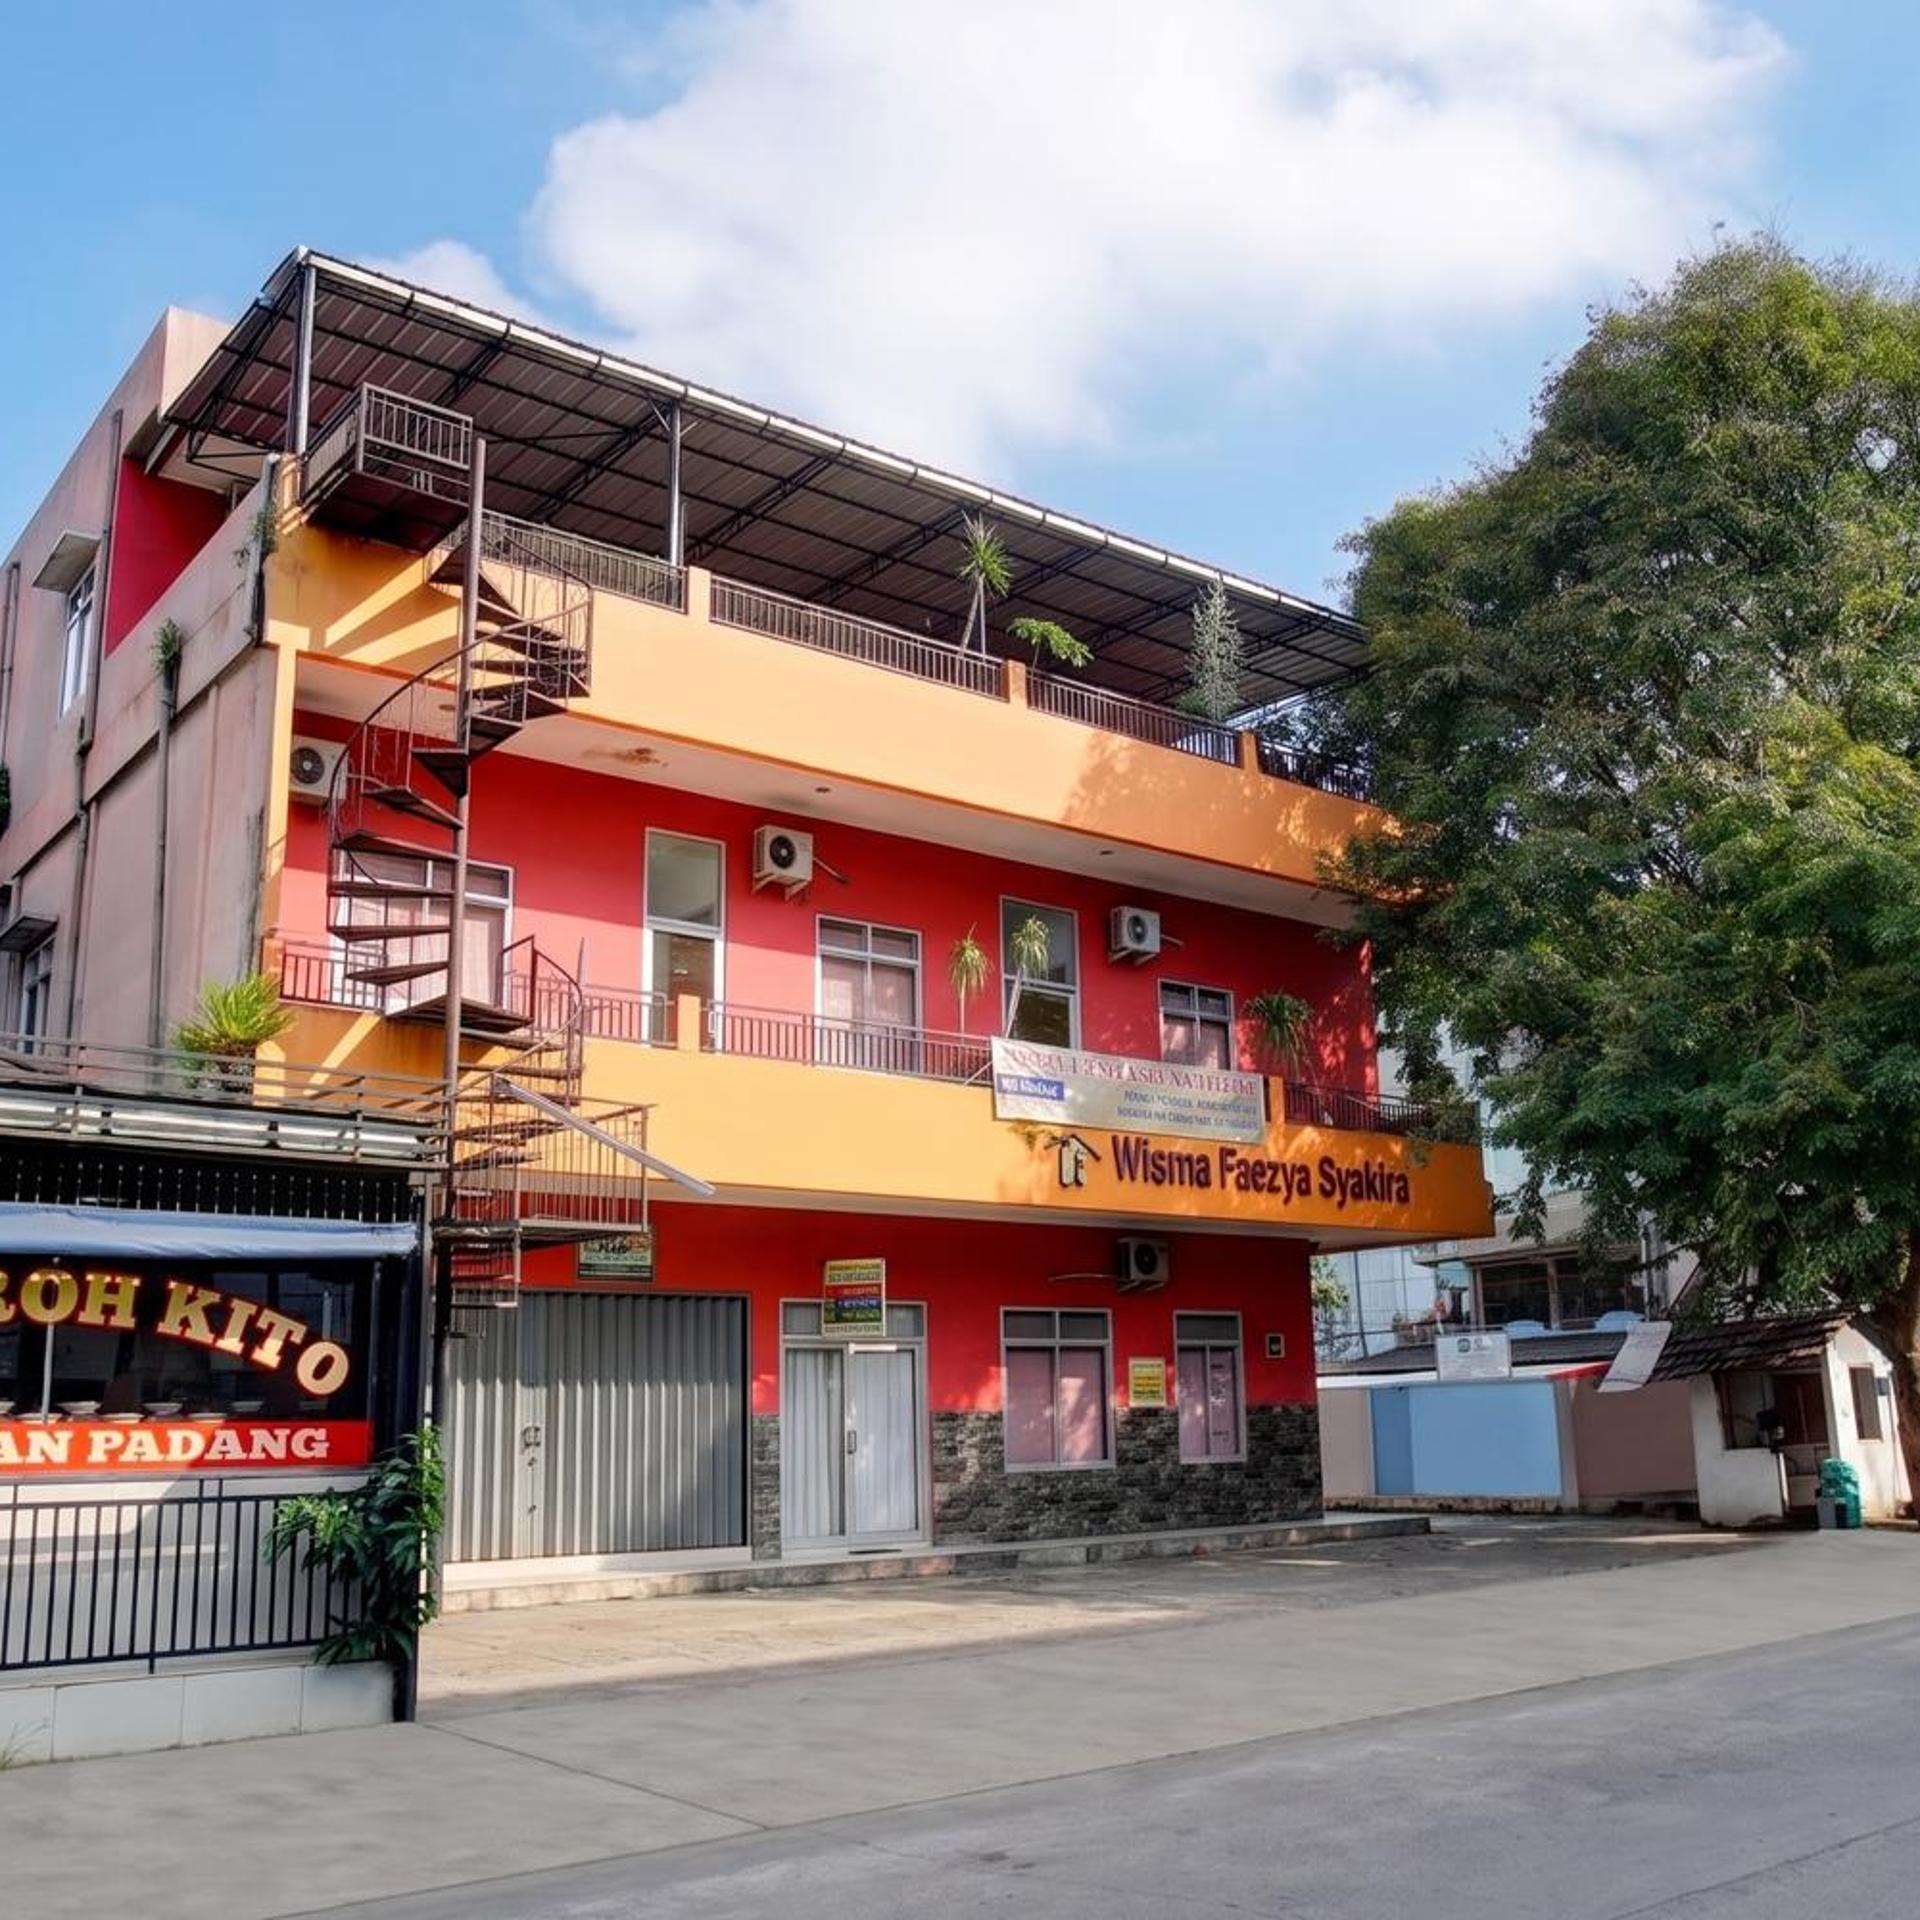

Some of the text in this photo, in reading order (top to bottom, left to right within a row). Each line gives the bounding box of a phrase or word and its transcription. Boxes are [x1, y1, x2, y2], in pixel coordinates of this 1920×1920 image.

[1112, 1134, 1411, 1209] Wisma Faezya Syakira
[157, 1280, 350, 1396] KITO
[87, 1427, 331, 1464] PADANG
